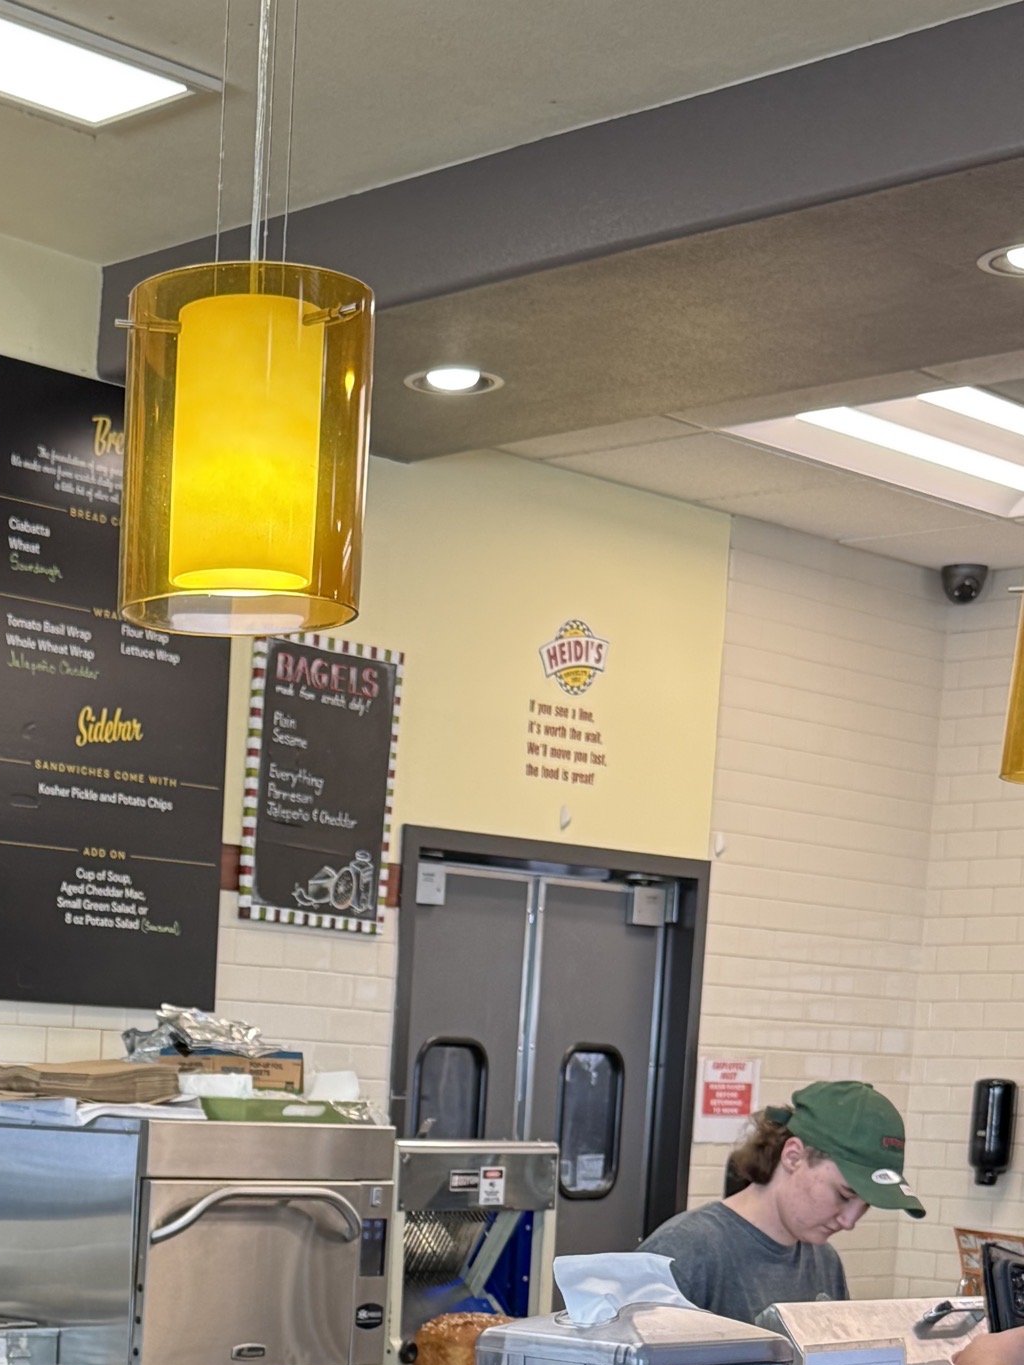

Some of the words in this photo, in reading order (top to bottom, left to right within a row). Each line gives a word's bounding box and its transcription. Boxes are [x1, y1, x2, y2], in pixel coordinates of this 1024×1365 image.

[8, 515, 50, 537] Ciabatta
[69, 507, 106, 524] BREAD
[8, 536, 40, 554] Wheat
[6, 612, 42, 631] Tomato
[43, 620, 65, 635] Basil
[66, 625, 91, 643] Wrap
[144, 629, 169, 646] Wrap
[5, 632, 36, 649] Whole
[37, 638, 67, 655] Wheat
[69, 645, 95, 662] Wrap
[120, 642, 154, 659] Lettuce
[155, 649, 180, 666] Wrap
[546, 640, 603, 670] HEIDI'S
[276, 652, 380, 698] BAGELS
[76, 705, 143, 747] Sidebar
[273, 710, 297, 730] Plain
[273, 728, 308, 750] Sesame
[34, 759, 110, 778] SANDWICHES
[113, 769, 144, 783] COME
[148, 774, 177, 787] WITH
[269, 763, 324, 796] Everything
[38, 781, 70, 798] Kosher
[70, 786, 98, 802] Pickle
[98, 790, 116, 804] and
[117, 792, 146, 808] Potato
[146, 796, 173, 813] Chips
[319, 809, 358, 830] Cheddar
[82, 846, 106, 858] ADD
[109, 849, 126, 860] ON
[75, 866, 95, 882] Cup
[96, 869, 106, 881] of
[60, 880, 84, 897] Aged
[85, 883, 123, 898] Cheddar
[56, 895, 81, 910] Small
[82, 898, 110, 912] Green
[137, 906, 148, 915] or
[64, 912, 72, 924] 8
[73, 915, 84, 925] oz
[84, 914, 113, 928] Potato
[114, 917, 139, 930] Salad
